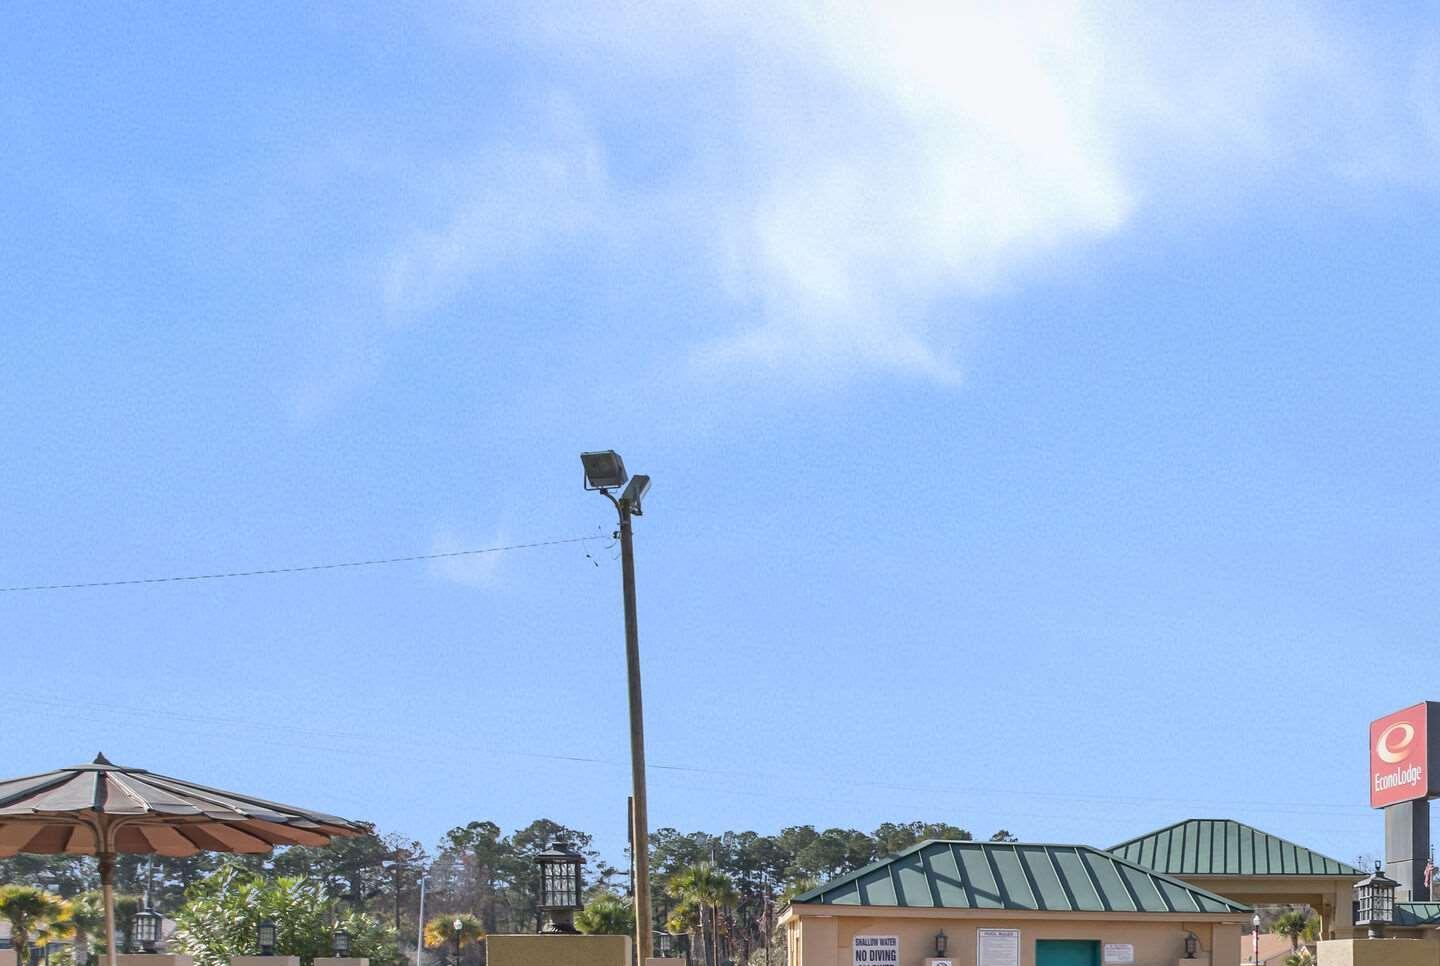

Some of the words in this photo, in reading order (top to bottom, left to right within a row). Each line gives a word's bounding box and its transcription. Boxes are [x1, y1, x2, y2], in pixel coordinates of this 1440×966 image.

[1375, 762, 1422, 792] EconoLodge
[855, 938, 878, 946] SHALLOW
[879, 938, 896, 946] WATER
[856, 949, 867, 961] NO
[870, 949, 896, 961] DIVING
